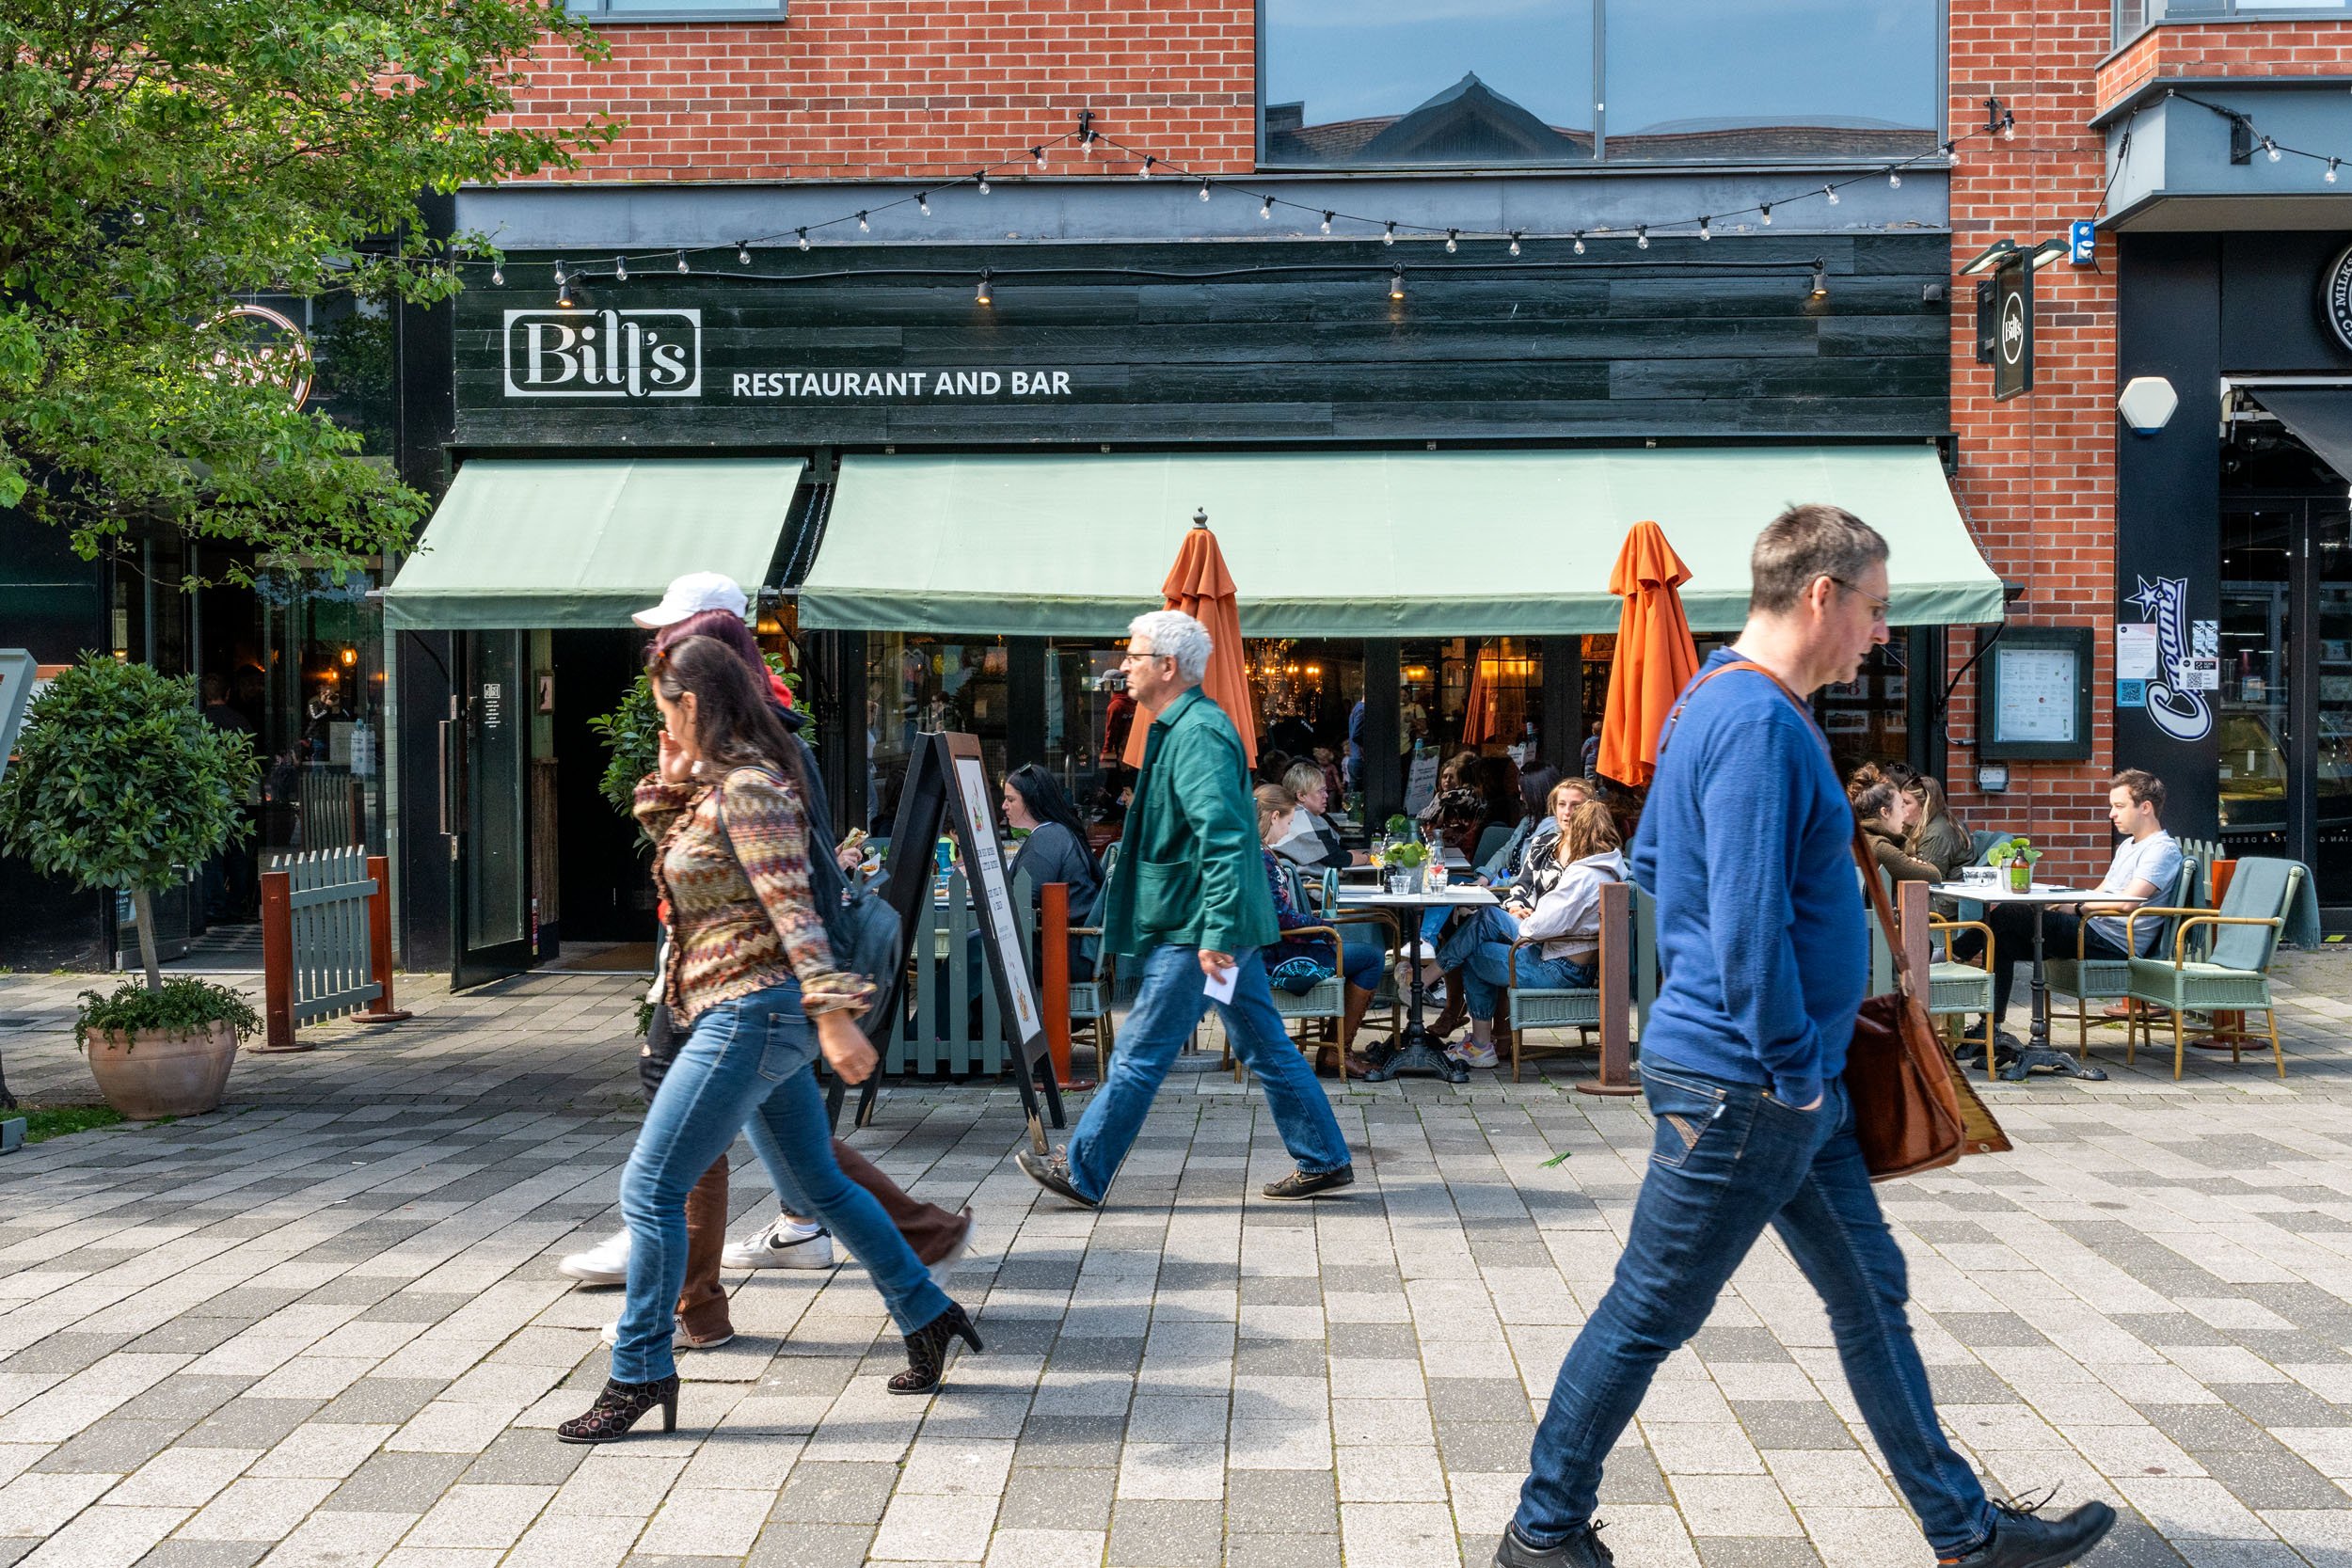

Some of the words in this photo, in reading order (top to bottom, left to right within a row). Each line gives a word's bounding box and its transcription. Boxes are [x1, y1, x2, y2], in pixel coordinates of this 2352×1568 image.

[2005, 313, 2022, 342] Bill's
[524, 309, 687, 396] Bill's
[733, 372, 927, 398] RESTAURANT
[934, 372, 1002, 396] AND
[1011, 371, 1073, 395] BAR
